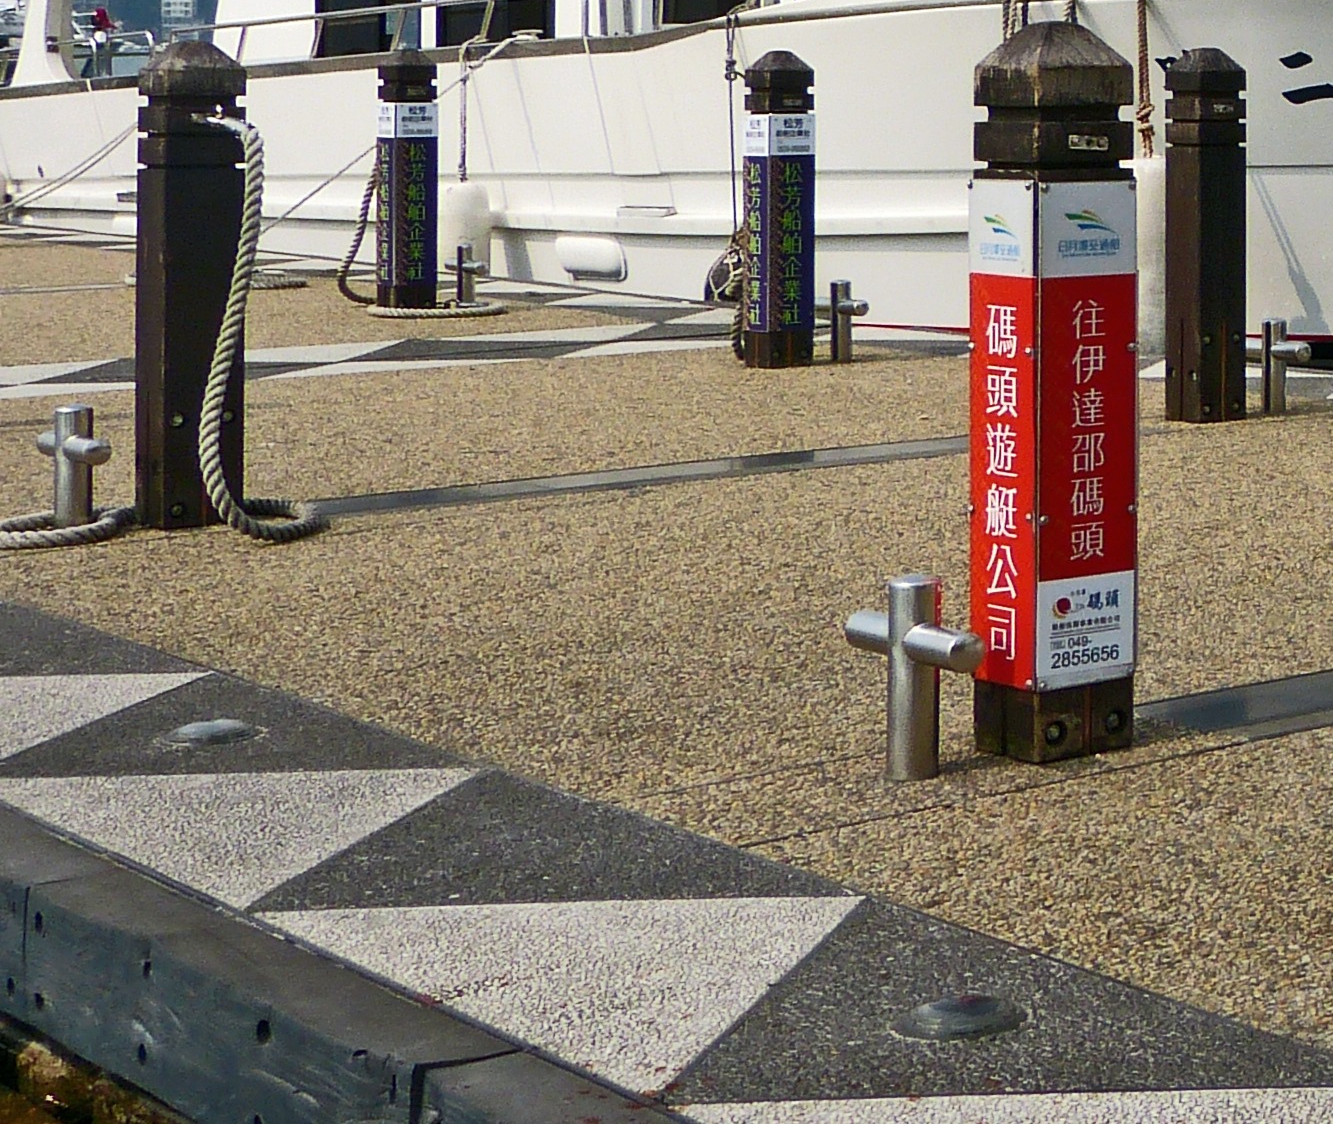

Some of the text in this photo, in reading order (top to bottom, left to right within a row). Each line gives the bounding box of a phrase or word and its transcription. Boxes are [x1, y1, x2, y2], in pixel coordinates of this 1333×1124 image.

[782, 162, 802, 325] 松芳船舶企業社
[984, 304, 1019, 661] 碼頭遊艇公司
[1069, 299, 1107, 561] 往伊達邵碼頭
[1050, 644, 1120, 670] 2855656
